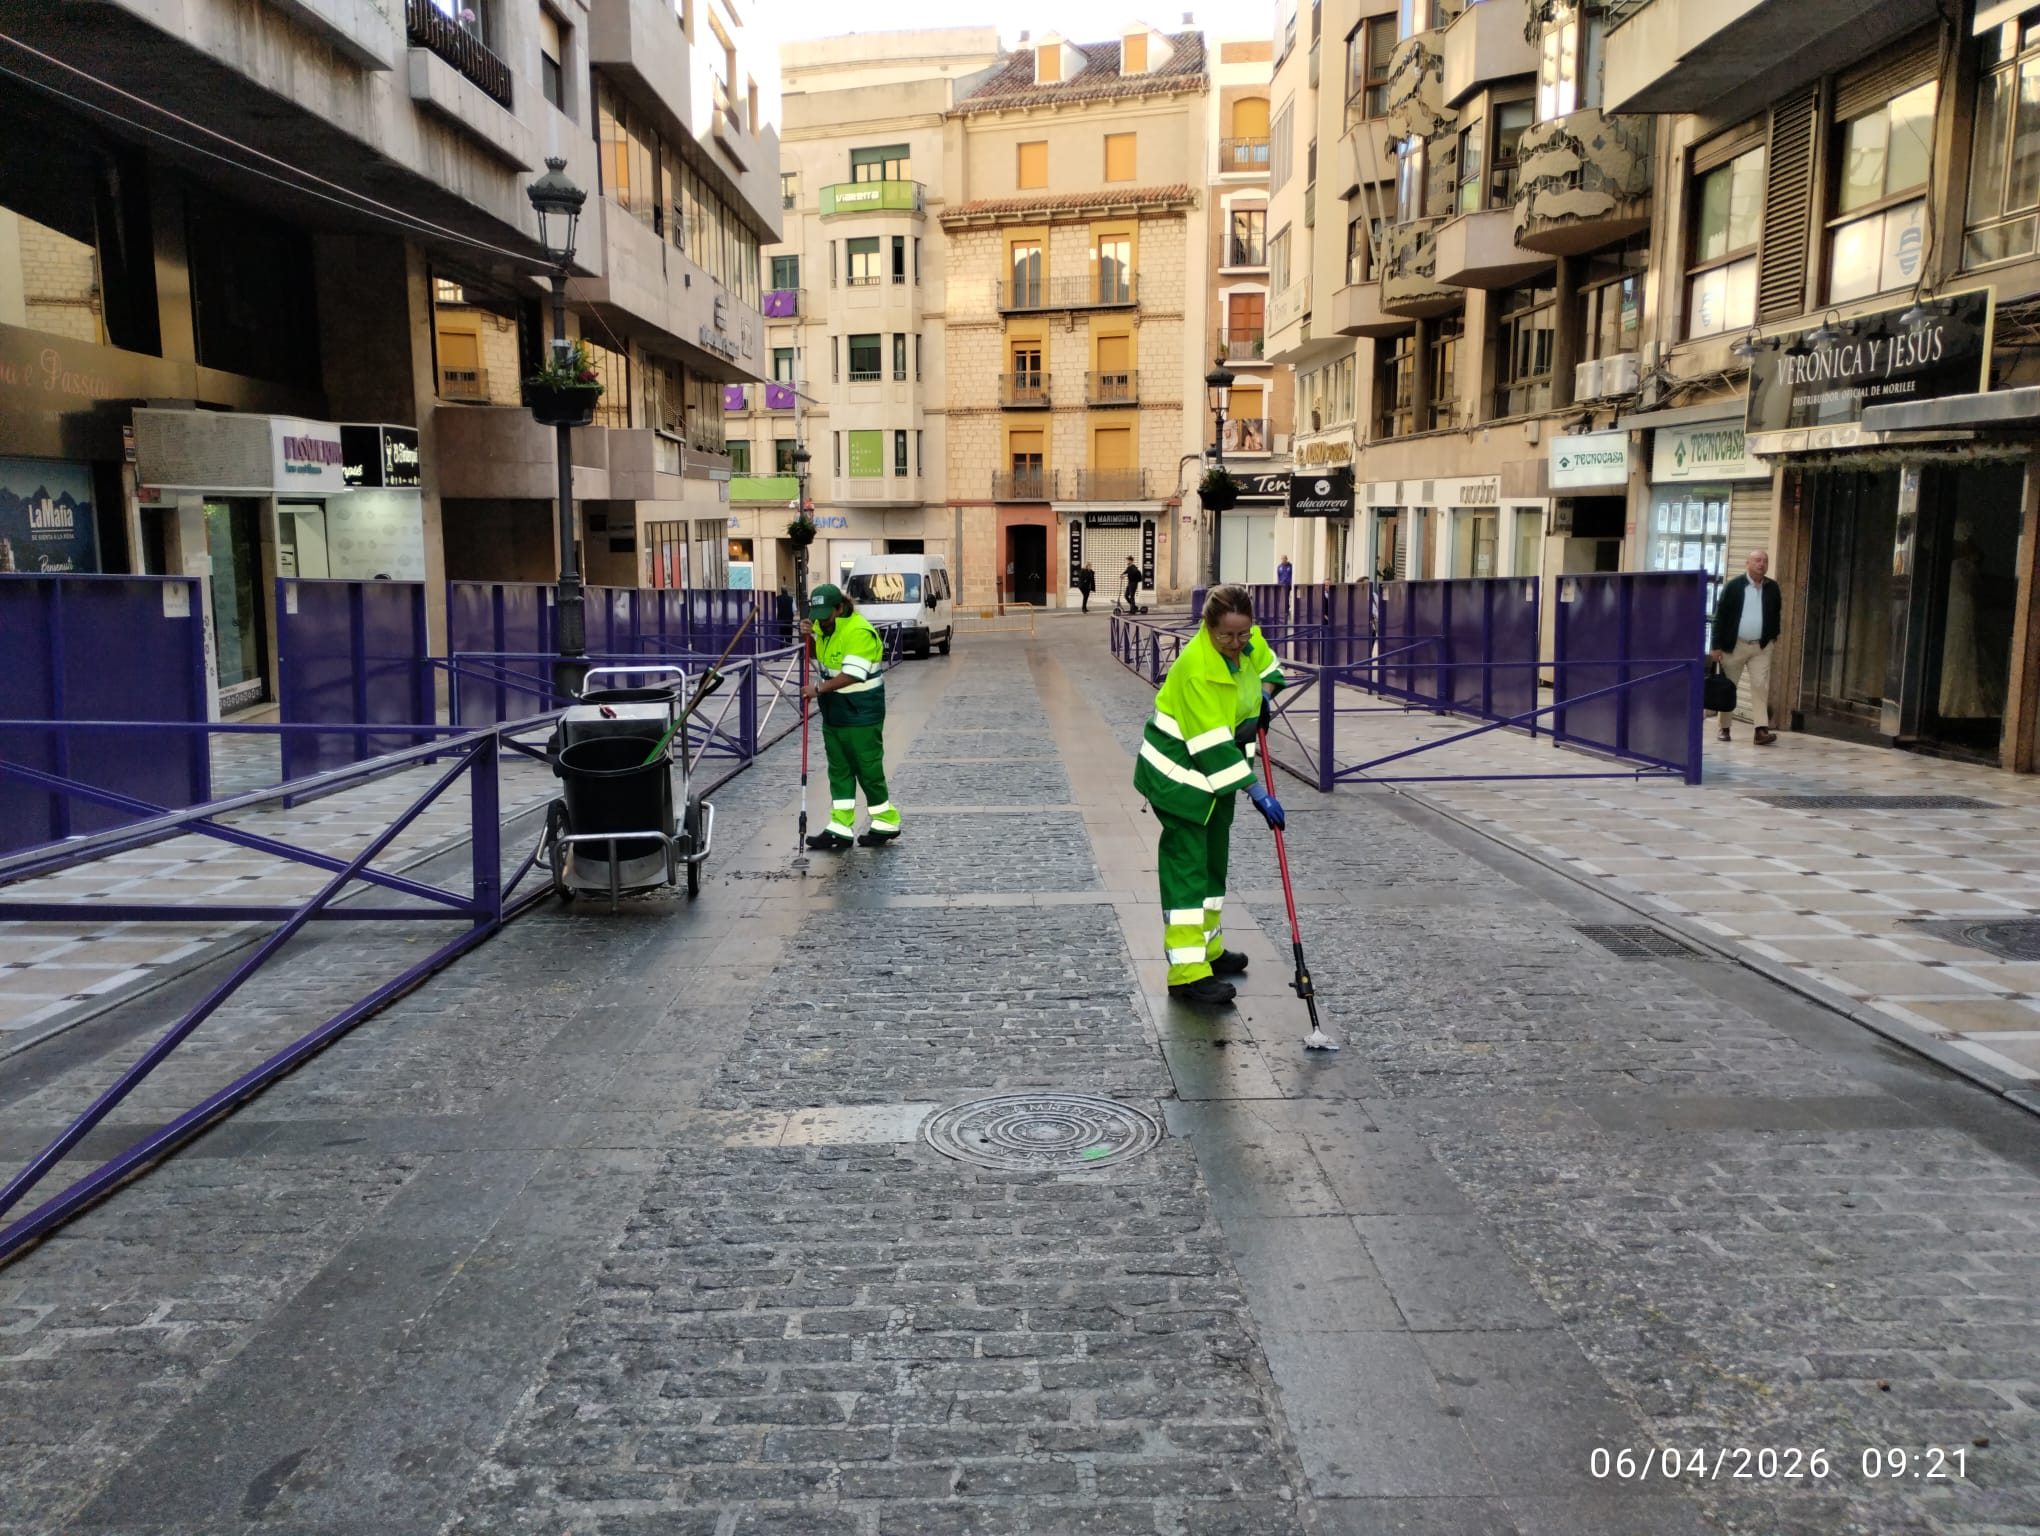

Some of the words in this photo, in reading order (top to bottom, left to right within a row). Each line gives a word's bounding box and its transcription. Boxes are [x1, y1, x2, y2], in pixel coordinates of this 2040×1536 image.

[1777, 343, 1863, 386] VERÓNICA
[1868, 339, 1881, 372] Y
[1885, 322, 1944, 378] JESÚS
[1792, 393, 1839, 407] DISTRIBUIDOR
[1841, 386, 1869, 399] OFICIAL
[1871, 384, 1881, 396] DE
[1882, 380, 1916, 395] MORILEE
[1690, 429, 1745, 463] TECNOCASA
[1574, 451, 1624, 465] TECNOCASA
[1296, 497, 1348, 508] alacarrera
[1088, 514, 1096, 523] LA
